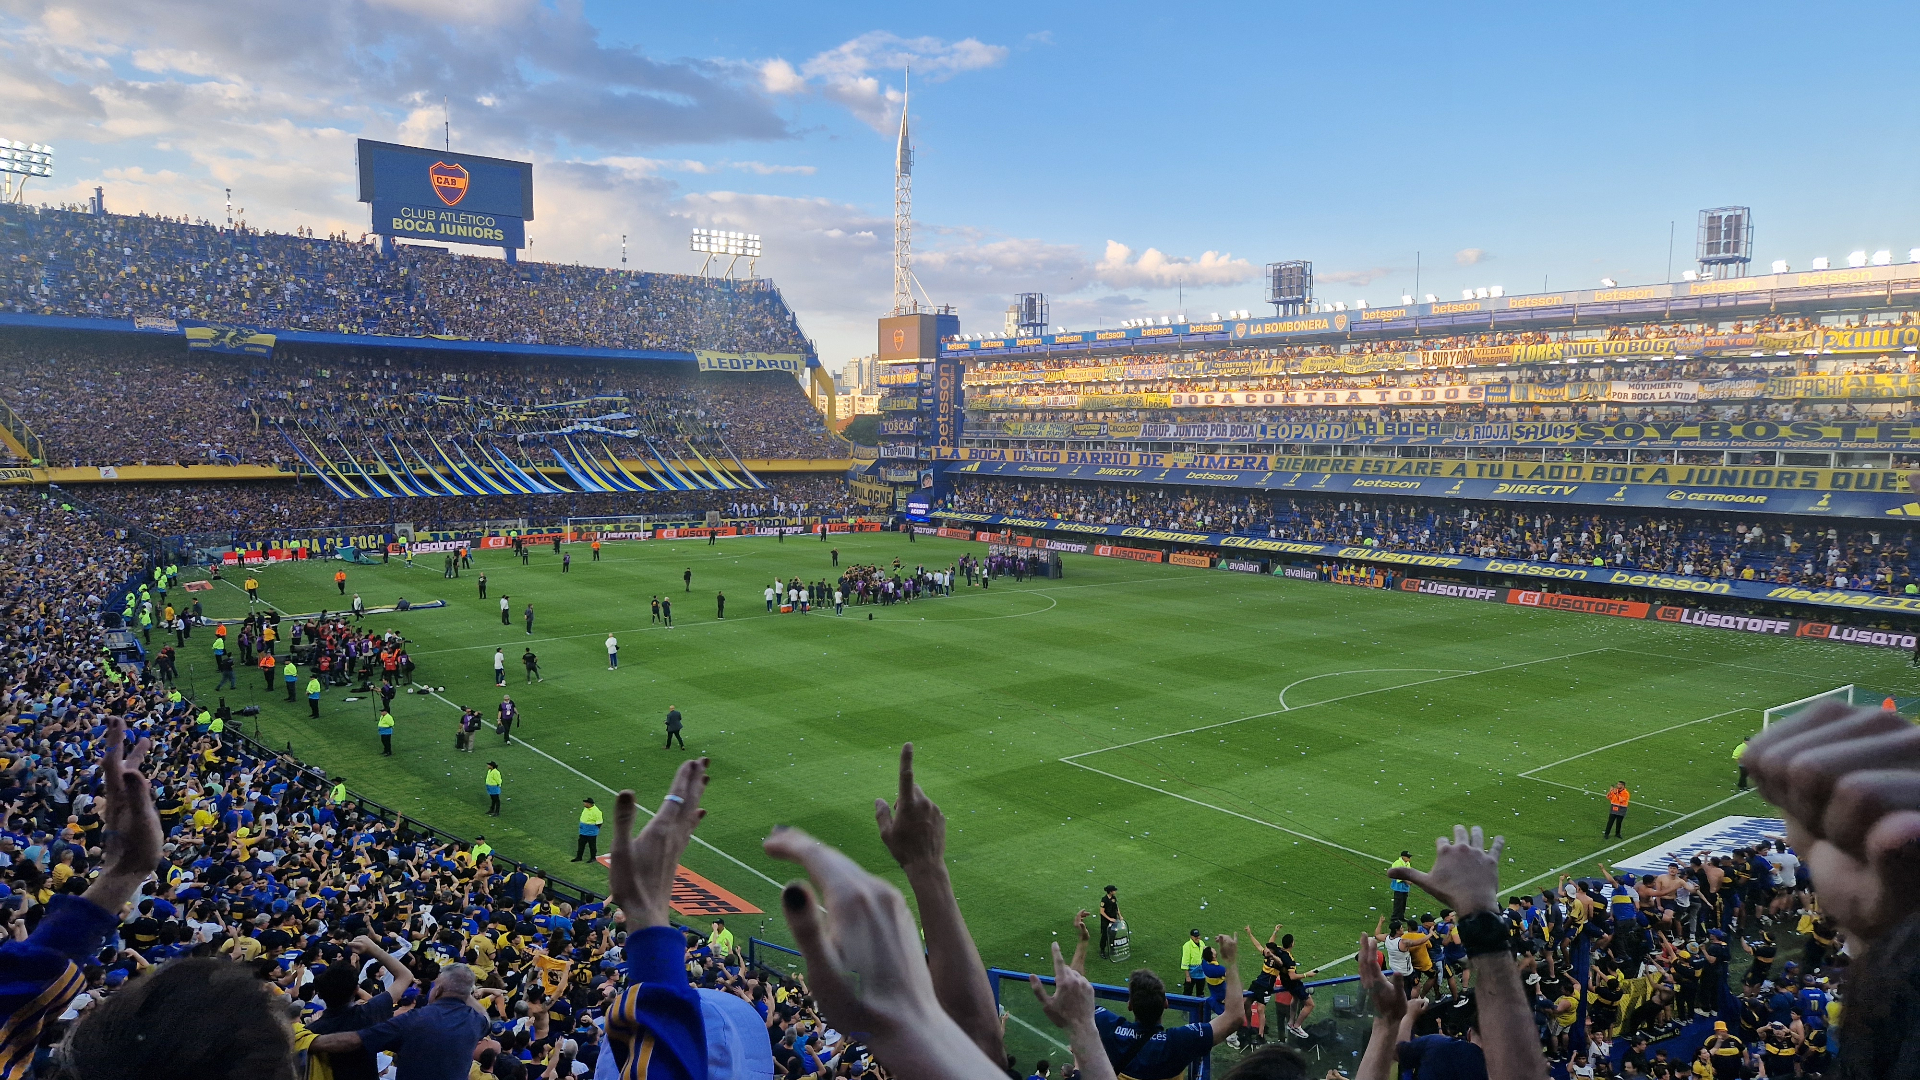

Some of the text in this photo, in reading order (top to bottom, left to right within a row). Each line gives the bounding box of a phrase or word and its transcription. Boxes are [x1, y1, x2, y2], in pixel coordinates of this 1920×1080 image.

[401, 206, 496, 227] CLUB ATLÉTICO
[393, 217, 504, 241] BOCA JUNIORS
[1798, 270, 1873, 287] betsson
[1689, 280, 1758, 296] betsson
[1595, 288, 1655, 302] betsson
[1431, 301, 1481, 315] betsson
[1508, 295, 1563, 309] betsson
[1362, 308, 1406, 321] betsson
[1141, 327, 1173, 337] betsson
[1189, 323, 1224, 333] betsson
[1250, 318, 1329, 335] LA BOMBONERA
[1055, 334, 1083, 343] betsson
[1096, 330, 1126, 340] betsson
[946, 343, 970, 351] betsson
[980, 340, 1005, 349] betsson
[1016, 338, 1042, 347] betsson
[1568, 341, 1627, 357] NUEVO
[1627, 338, 1677, 353] BOCA
[1704, 338, 1726, 347] AZUL
[1729, 338, 1735, 346] Y
[1736, 337, 1754, 346] ORO
[1476, 347, 1511, 356] VIEDMA
[1513, 343, 1564, 363] FLORES
[706, 357, 798, 371] LEOPARDI
[1628, 382, 1683, 390] MOVIMIENTO
[1173, 393, 1234, 405] BOCA
[1246, 391, 1362, 404] CONTRA
[1376, 387, 1483, 402] TODOS
[1612, 391, 1697, 400] POR BOCA LA VIDA
[883, 421, 914, 432] TOSCAS
[1141, 423, 1255, 438] AGRUP. JUNTOS POR BOCA
[1256, 423, 1350, 439] LEOPARDI
[1384, 422, 1440, 436] BOCA
[1472, 424, 1509, 440] RIOJA
[1578, 421, 1684, 441] SOY
[883, 446, 913, 457] LEOPARDI
[936, 447, 961, 459] LA
[968, 448, 1007, 460] BOCA
[1067, 451, 1131, 465] BARRIO
[1138, 453, 1165, 467] DE
[1094, 467, 1142, 476] DIRECTV
[1186, 471, 1240, 481] betsson
[1274, 457, 1356, 472] SIEMPRE
[1360, 460, 1443, 476] ESTARE
[1450, 463, 1467, 477] A
[1476, 463, 1504, 477] TU
[1591, 466, 1670, 484] BOCA
[1677, 468, 1819, 488] JUNIORS
[1830, 472, 1897, 490] QUE
[1352, 478, 1421, 489] betsson
[1493, 483, 1579, 496] DIRECTV
[1687, 492, 1768, 504] CETROGAR
[999, 517, 1047, 528] betsson
[1055, 522, 1108, 534] betsson
[1172, 554, 1206, 566] betsson
[1229, 560, 1260, 573] avalian
[1285, 567, 1318, 580] avalian
[1485, 559, 1588, 580] betsson
[1610, 571, 1731, 594] betsson
